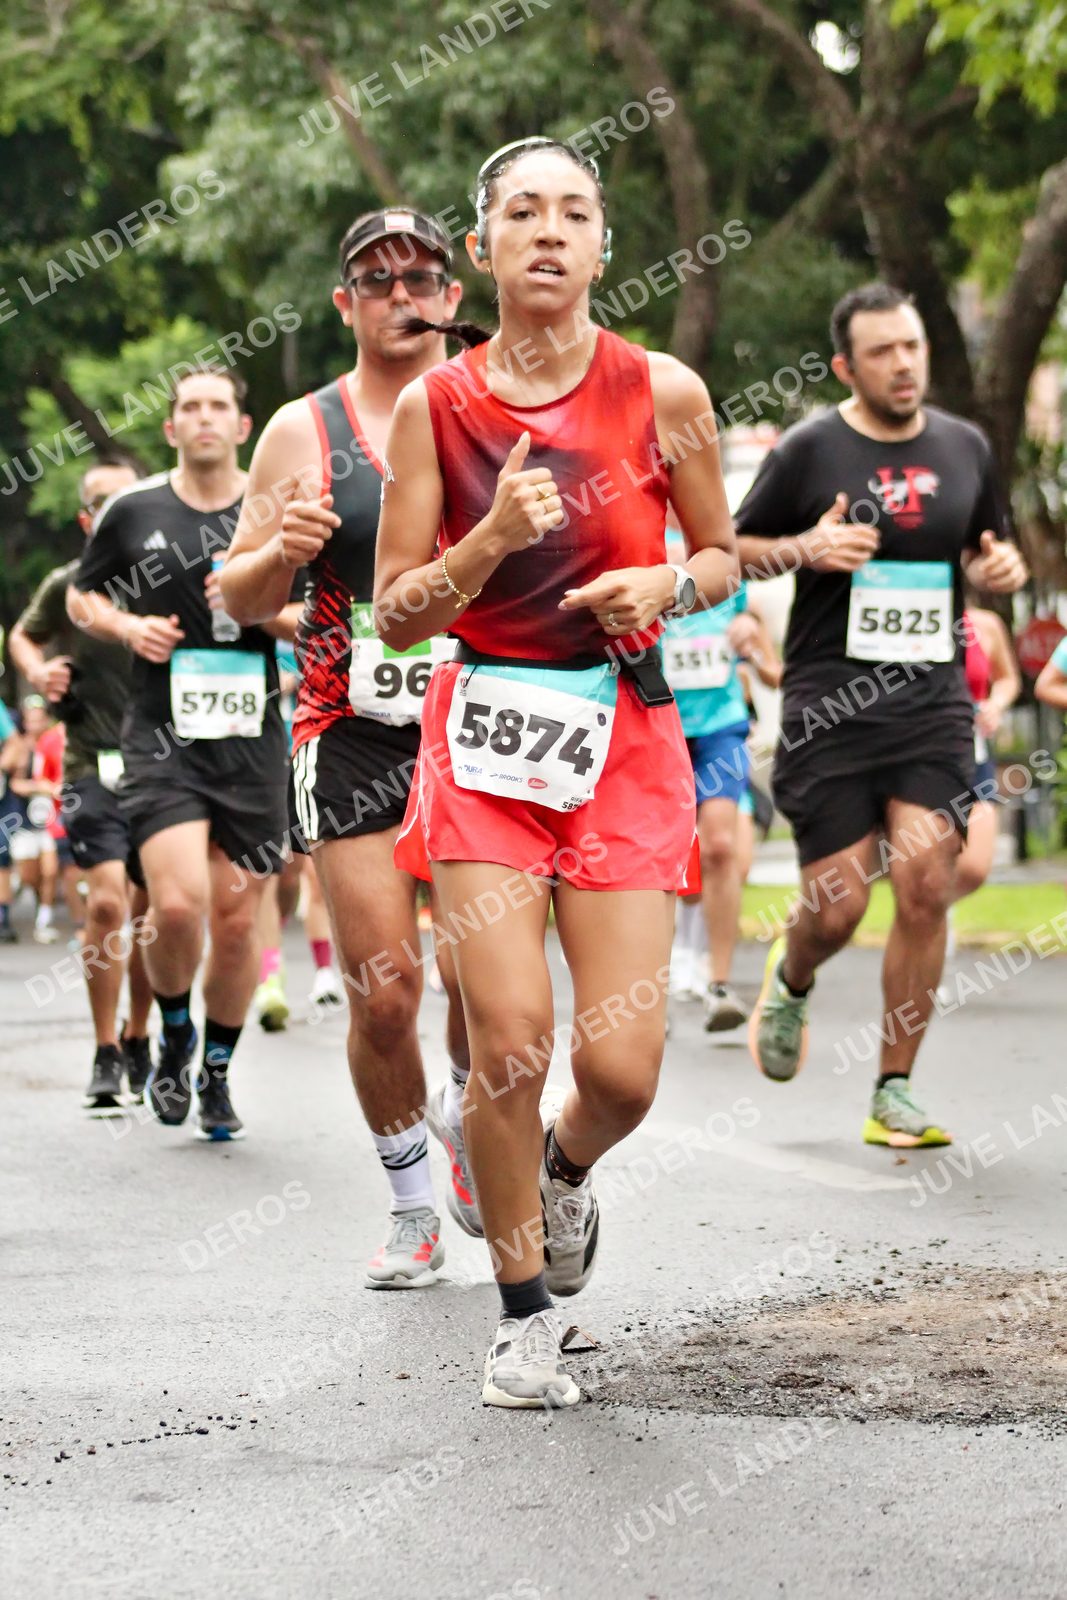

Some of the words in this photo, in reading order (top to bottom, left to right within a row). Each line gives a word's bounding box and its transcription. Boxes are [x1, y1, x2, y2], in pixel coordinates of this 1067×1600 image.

[858, 607, 941, 636] 5825
[373, 661, 432, 700] 96
[180, 691, 258, 716] 5768
[455, 702, 594, 777] 5874
